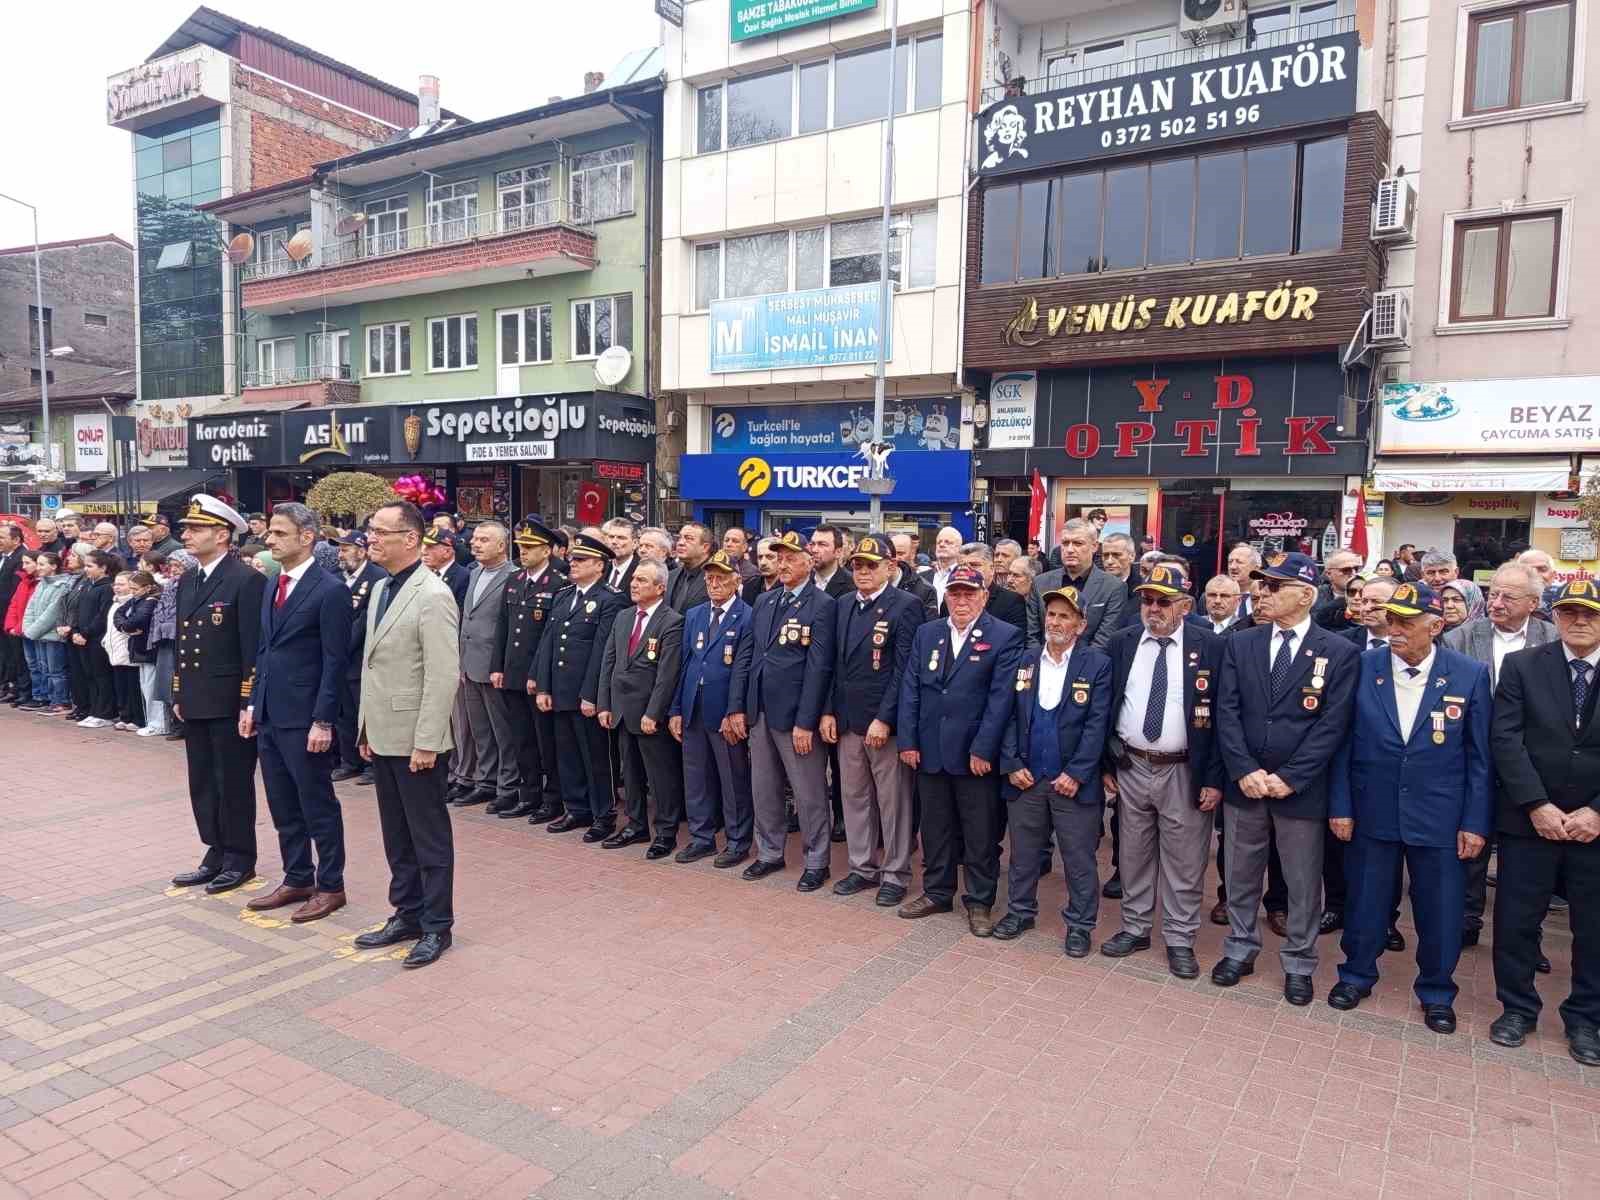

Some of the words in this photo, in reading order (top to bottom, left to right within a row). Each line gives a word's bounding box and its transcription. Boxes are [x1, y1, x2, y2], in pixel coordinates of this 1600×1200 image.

[1034, 77, 1175, 135] REYHAN
[1190, 42, 1347, 107] KUAFÖR
[1160, 117, 1197, 138] 502
[1206, 113, 1228, 131] 51
[1235, 104, 1260, 126] 96
[1047, 295, 1157, 336] VENÜS
[1165, 279, 1318, 330] KUAFÖR
[716, 319, 743, 354] M
[764, 328, 828, 354] İSMAİL
[996, 383, 1022, 398] SGK
[427, 397, 585, 442] Sepetçioğlu
[599, 414, 656, 438] Sepetçioğlu
[747, 419, 800, 433] Turkcell'le
[990, 415, 1032, 430] GÖZLÜKÇÜ
[1510, 404, 1593, 424] BEYAZ
[77, 427, 104, 442] ONUR
[196, 417, 268, 441] Karadeniz
[750, 432, 788, 447] bağlan
[791, 431, 834, 446] hayata!
[1065, 407, 1337, 459] OPTİK
[1480, 427, 1551, 442] ÇAYCUMA
[1554, 427, 1594, 440] SATIŞ
[79, 447, 103, 456] TEKEL
[211, 442, 251, 466] Optik
[494, 446, 518, 458] YEMEK
[520, 444, 548, 457] SALONU
[773, 465, 872, 489] TURKCE
